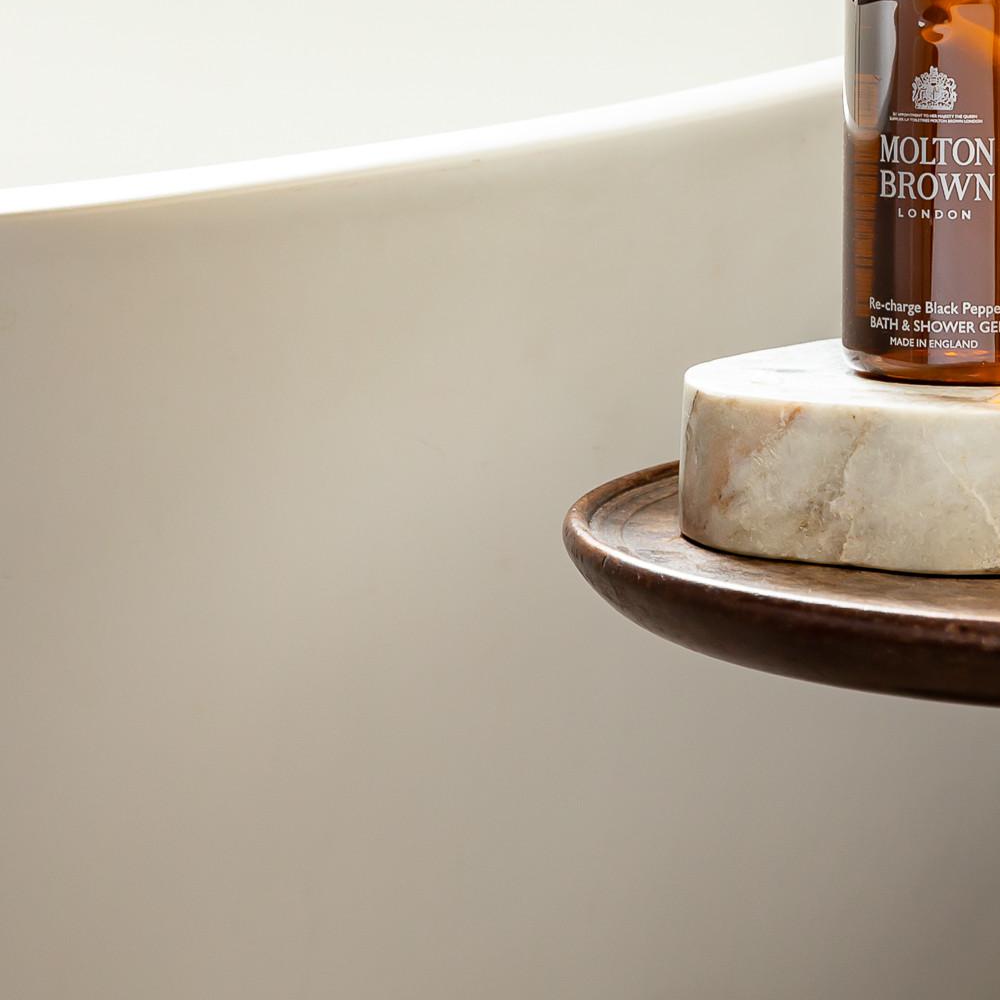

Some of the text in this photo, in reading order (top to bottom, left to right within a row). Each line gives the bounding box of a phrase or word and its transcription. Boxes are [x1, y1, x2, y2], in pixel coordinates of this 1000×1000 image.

[880, 134, 995, 166] MOLTON
[880, 169, 995, 201] BROWN
[898, 207, 972, 220] LONDON
[869, 296, 922, 316] Re-charge
[925, 301, 959, 315] Black
[870, 316, 899, 331] BATH
[901, 319, 911, 332] &
[913, 319, 976, 334] SHOWER
[889, 336, 979, 349] MADE IN ENGLAND
